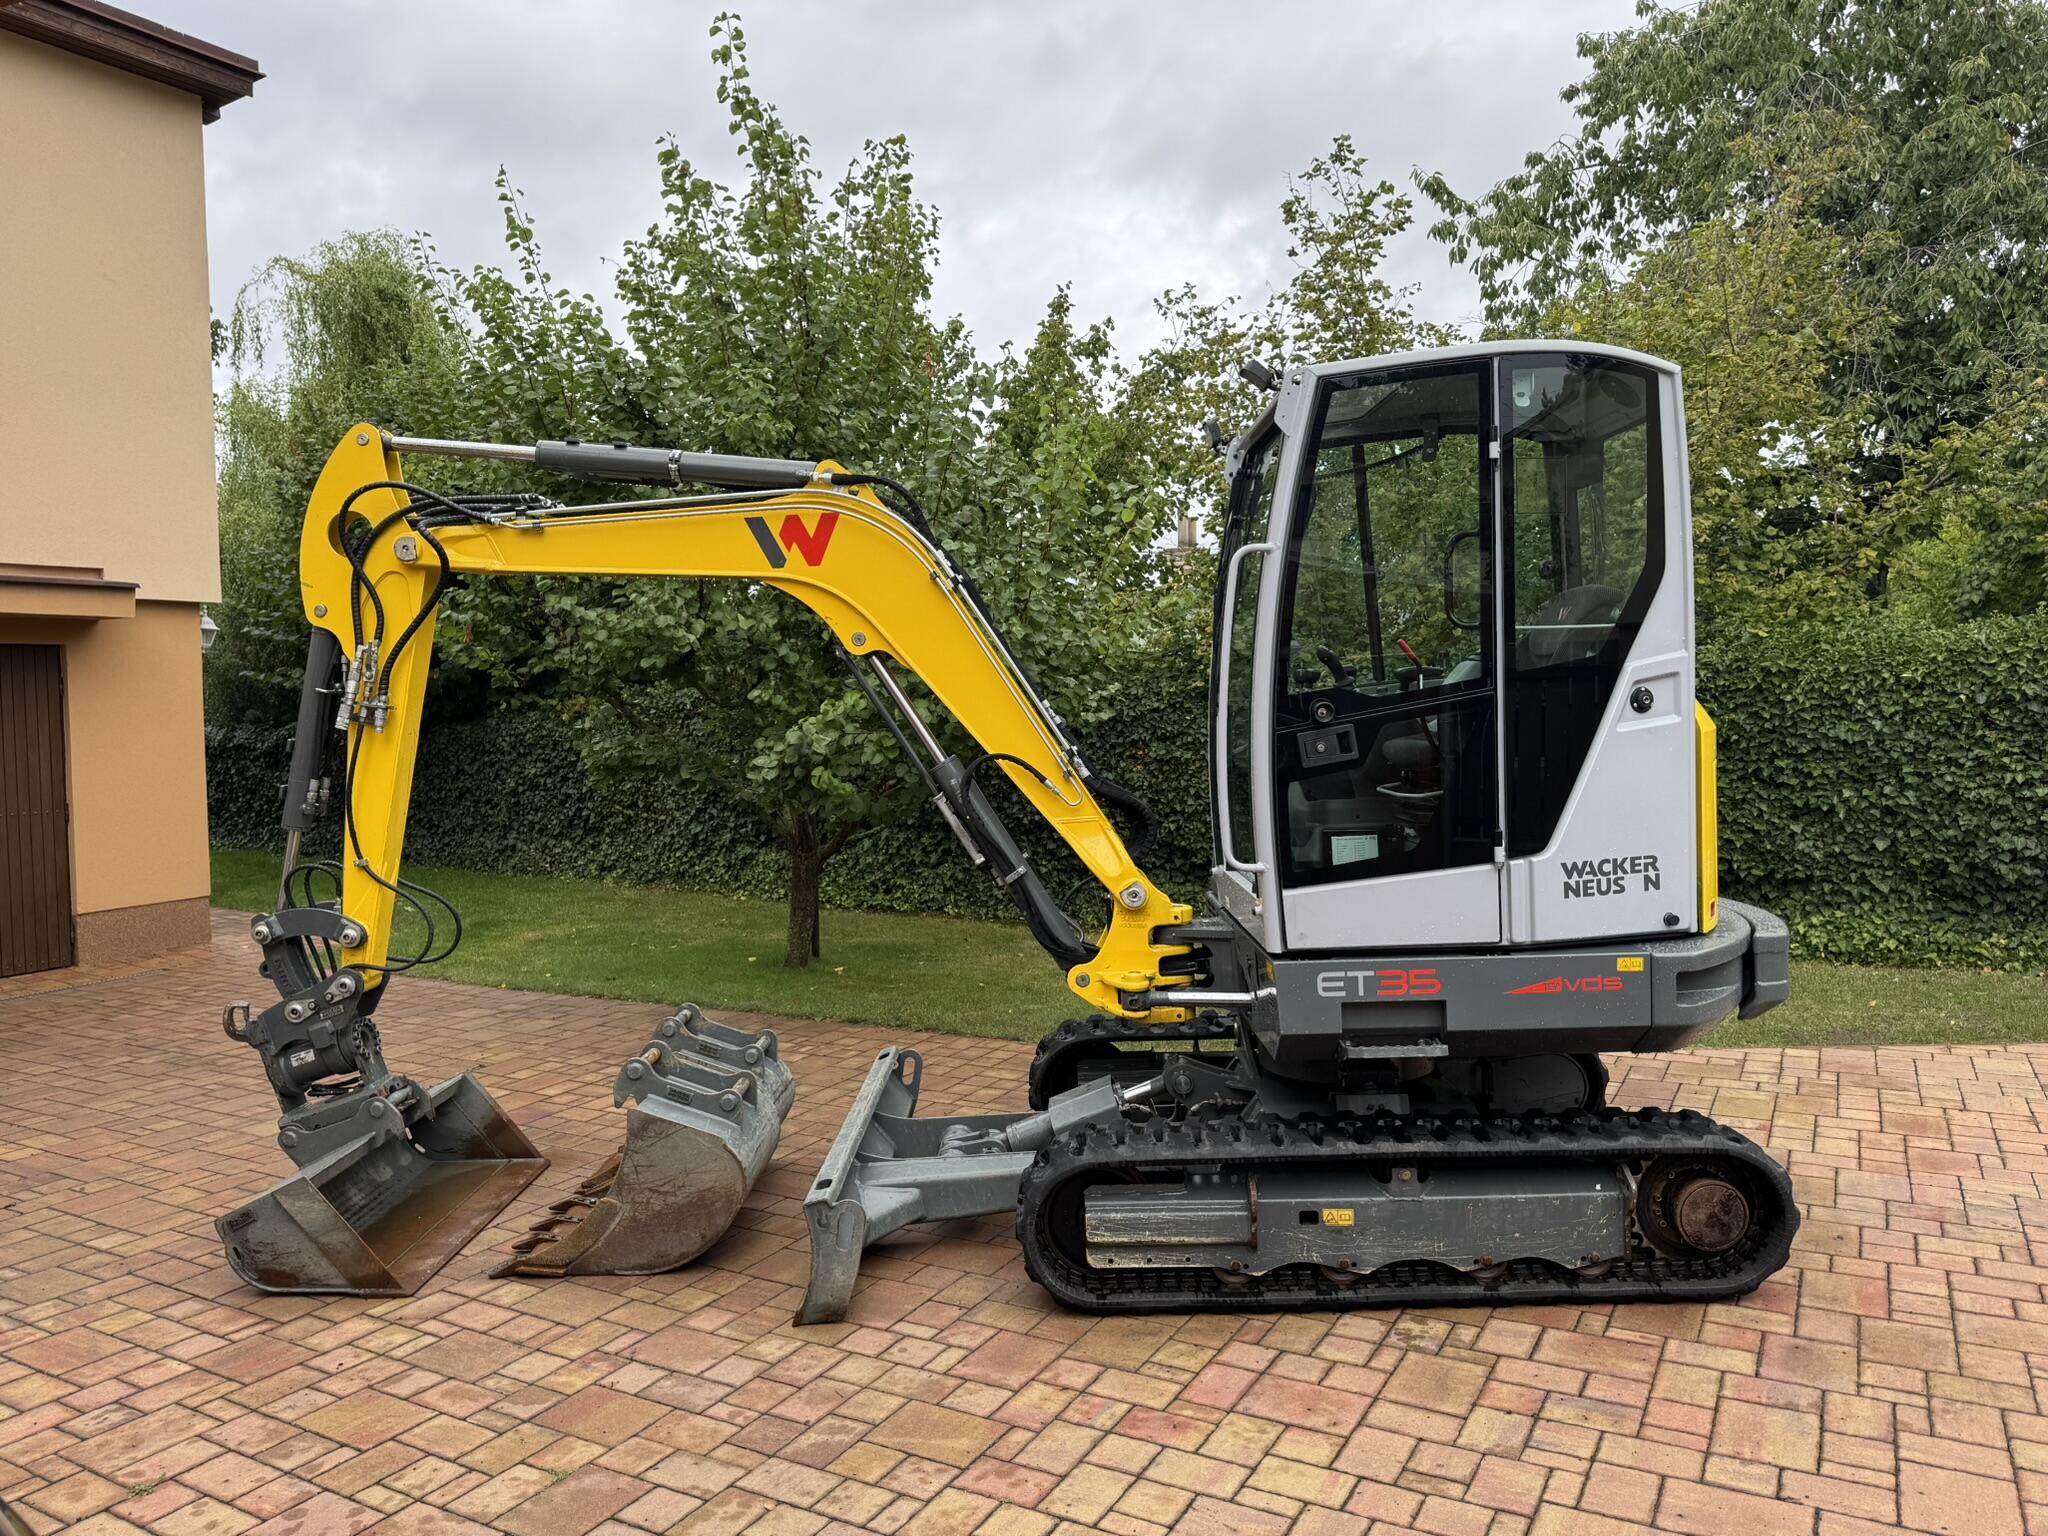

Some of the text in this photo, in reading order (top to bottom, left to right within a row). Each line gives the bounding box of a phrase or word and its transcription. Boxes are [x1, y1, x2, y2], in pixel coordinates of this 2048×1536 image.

[1560, 854, 1660, 880] WACKER
[1316, 968, 1442, 997] ET35
[1563, 976, 1624, 992] vds
